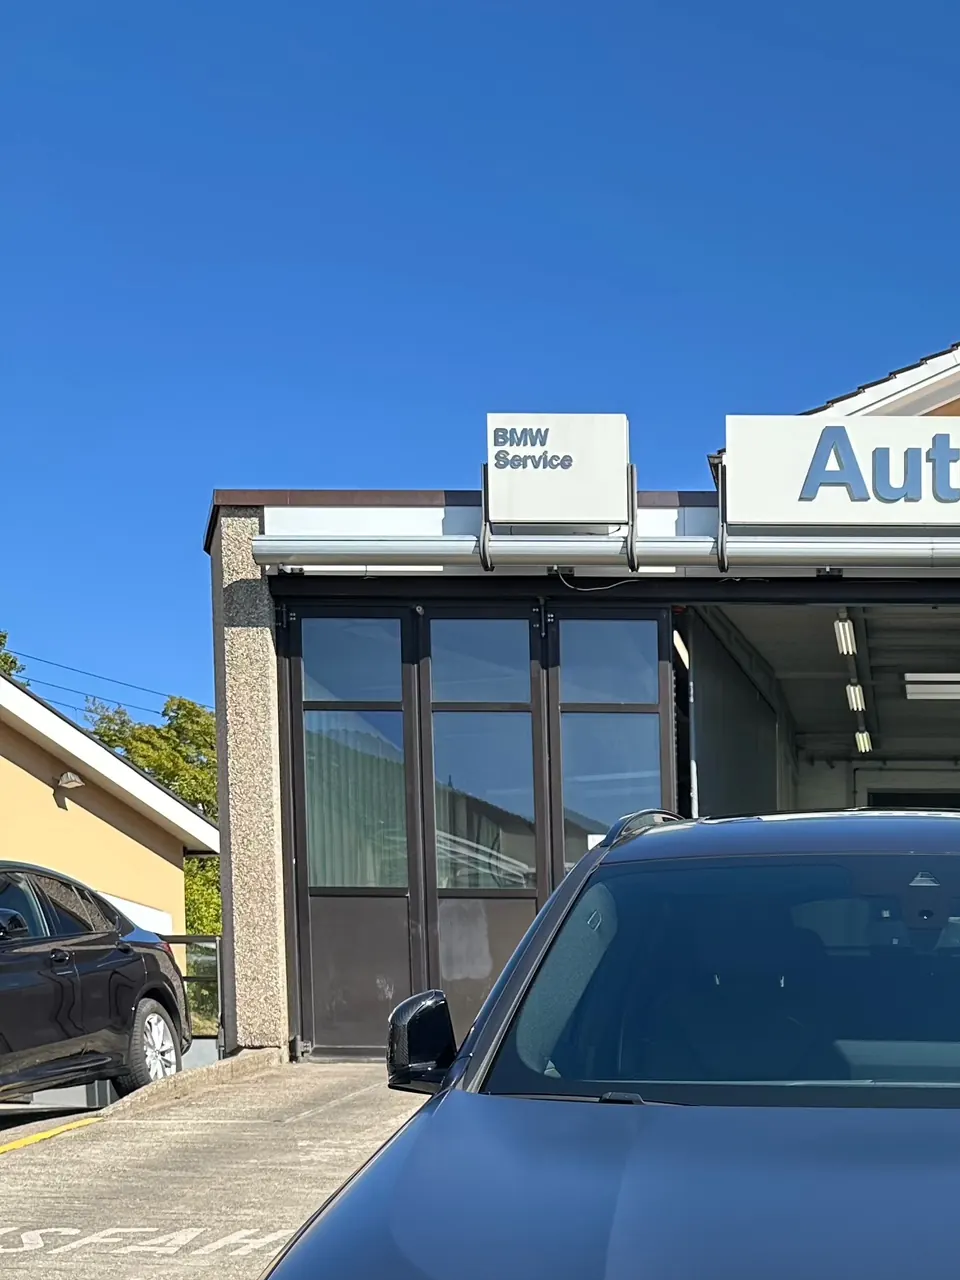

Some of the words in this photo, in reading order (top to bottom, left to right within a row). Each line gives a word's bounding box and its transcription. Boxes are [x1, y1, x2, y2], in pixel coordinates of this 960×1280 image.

[493, 428, 549, 447] BMW
[494, 450, 573, 470] Service
[0, 1227, 296, 1255] SFAH
